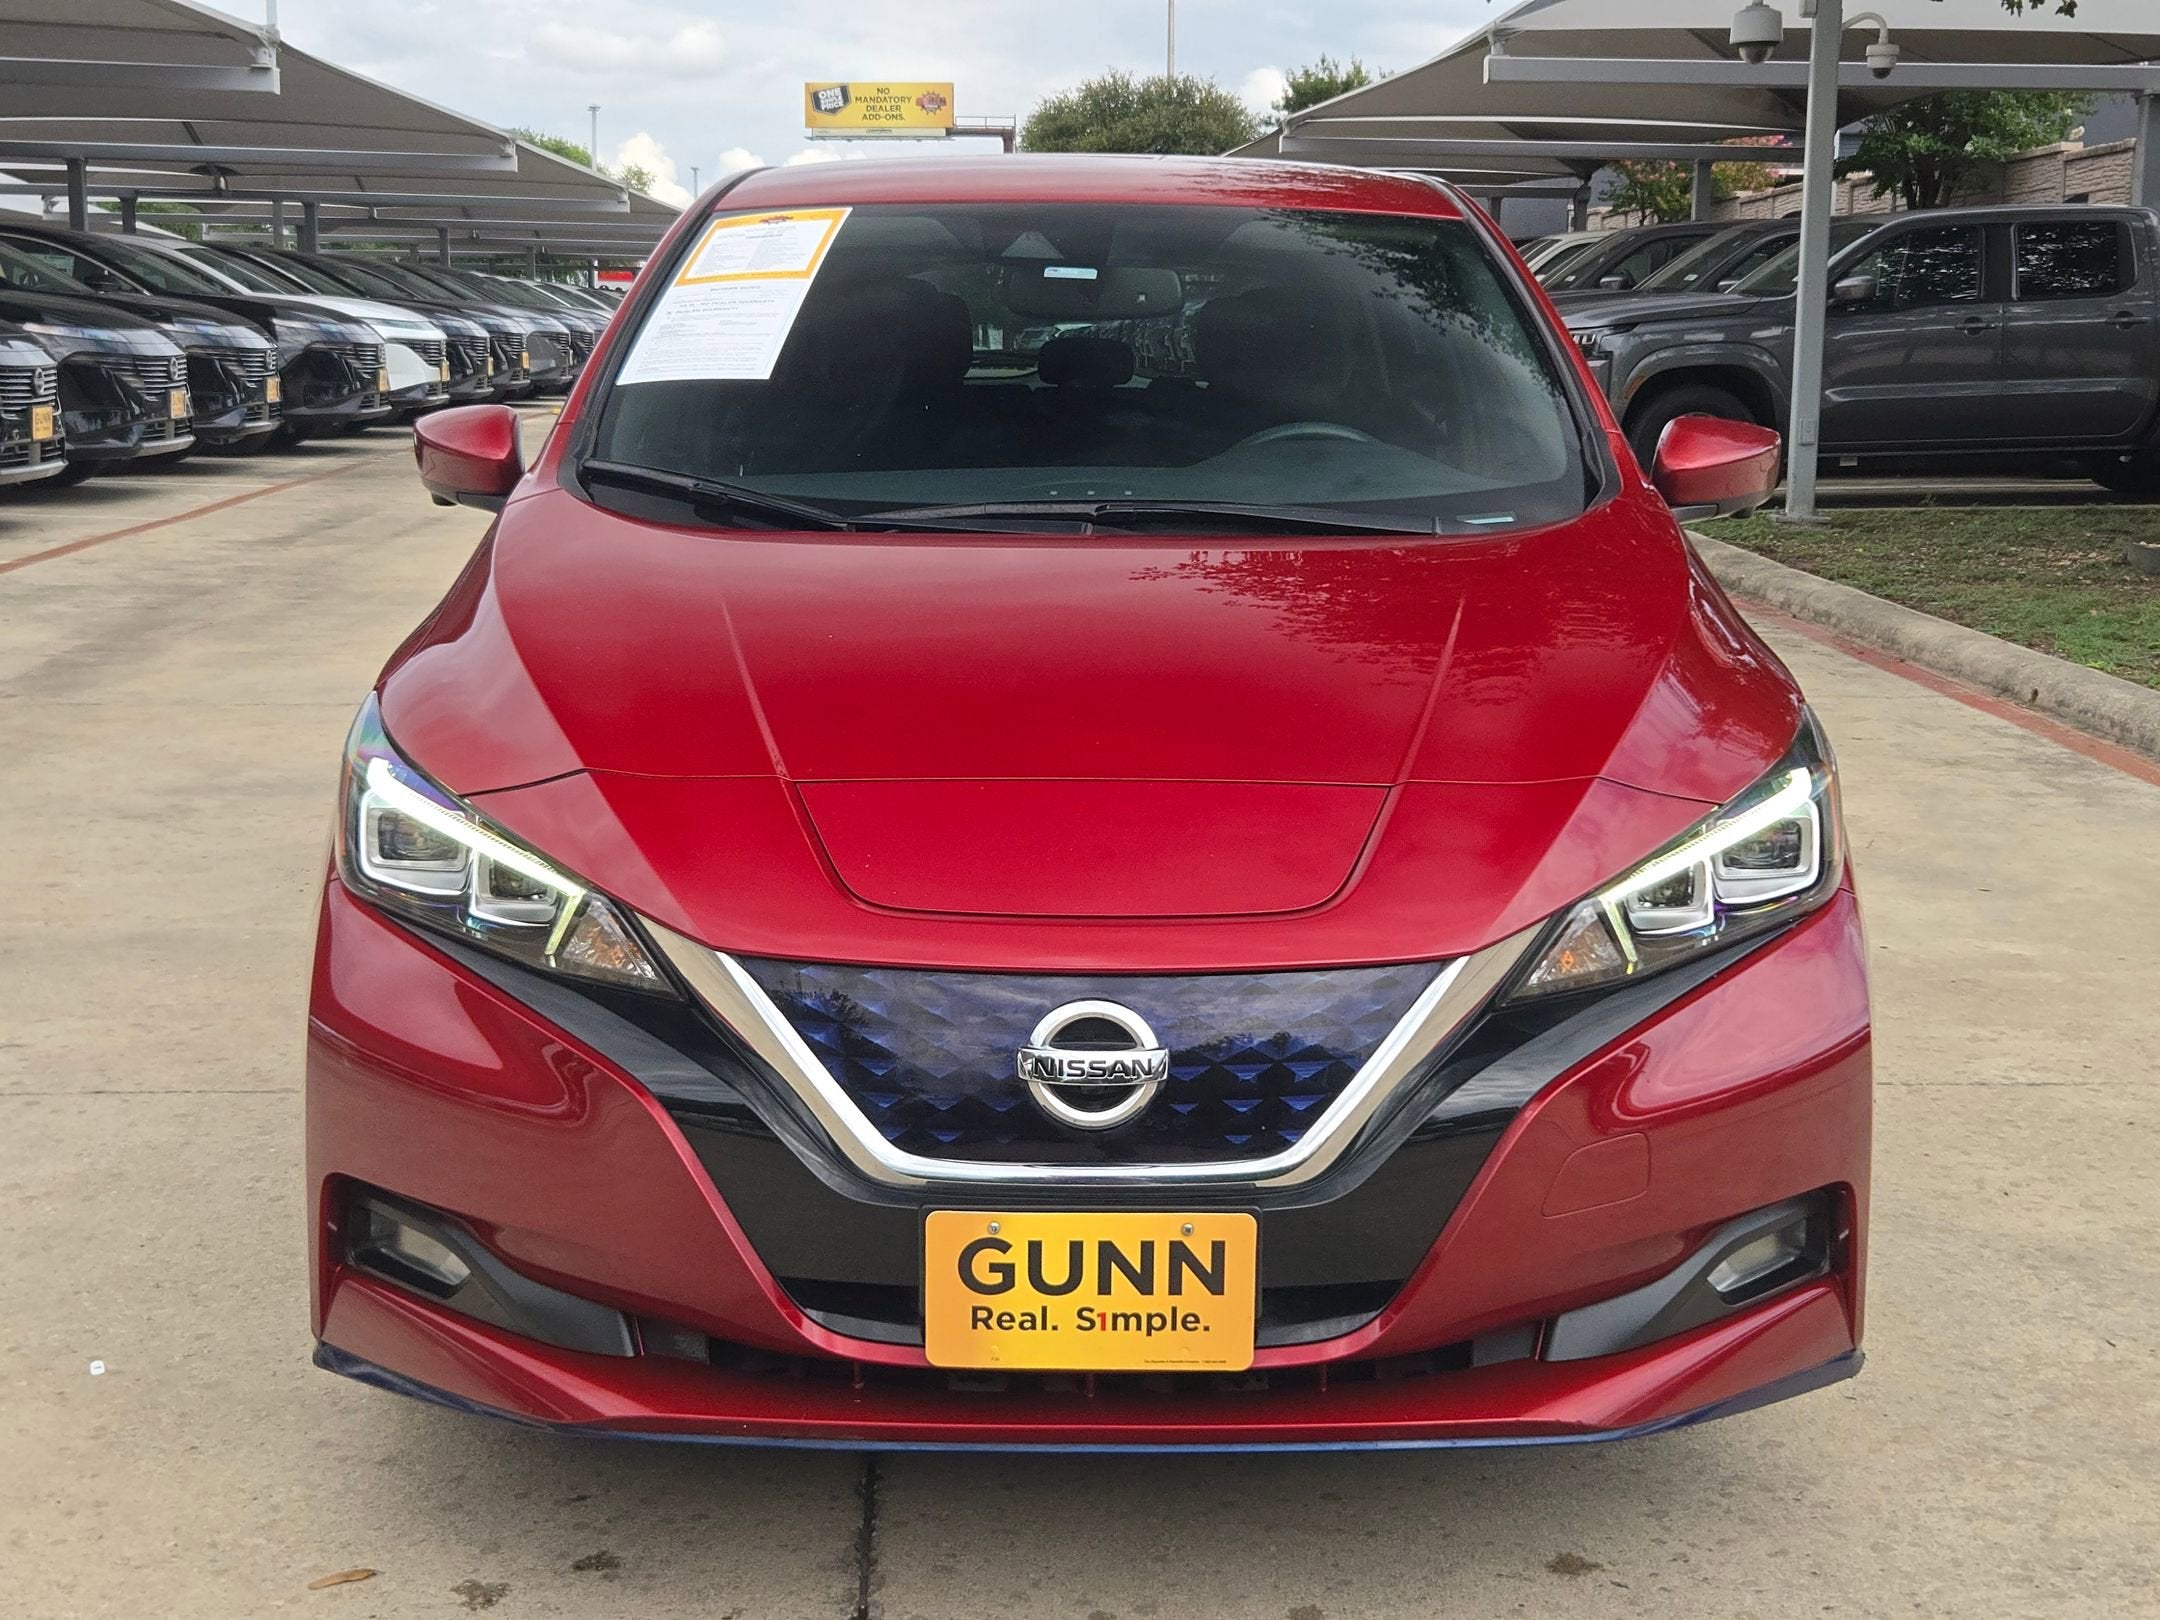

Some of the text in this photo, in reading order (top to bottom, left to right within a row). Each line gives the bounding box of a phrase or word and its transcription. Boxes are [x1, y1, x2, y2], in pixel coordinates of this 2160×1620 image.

[819, 87, 841, 98] ONE
[855, 96, 912, 104] MANDATORY
[821, 102, 844, 110] PRICE
[1033, 1057, 1152, 1079] NISSAN
[957, 1237, 1226, 1296] GUNN
[971, 1305, 1210, 1337] Real. S1mple.
